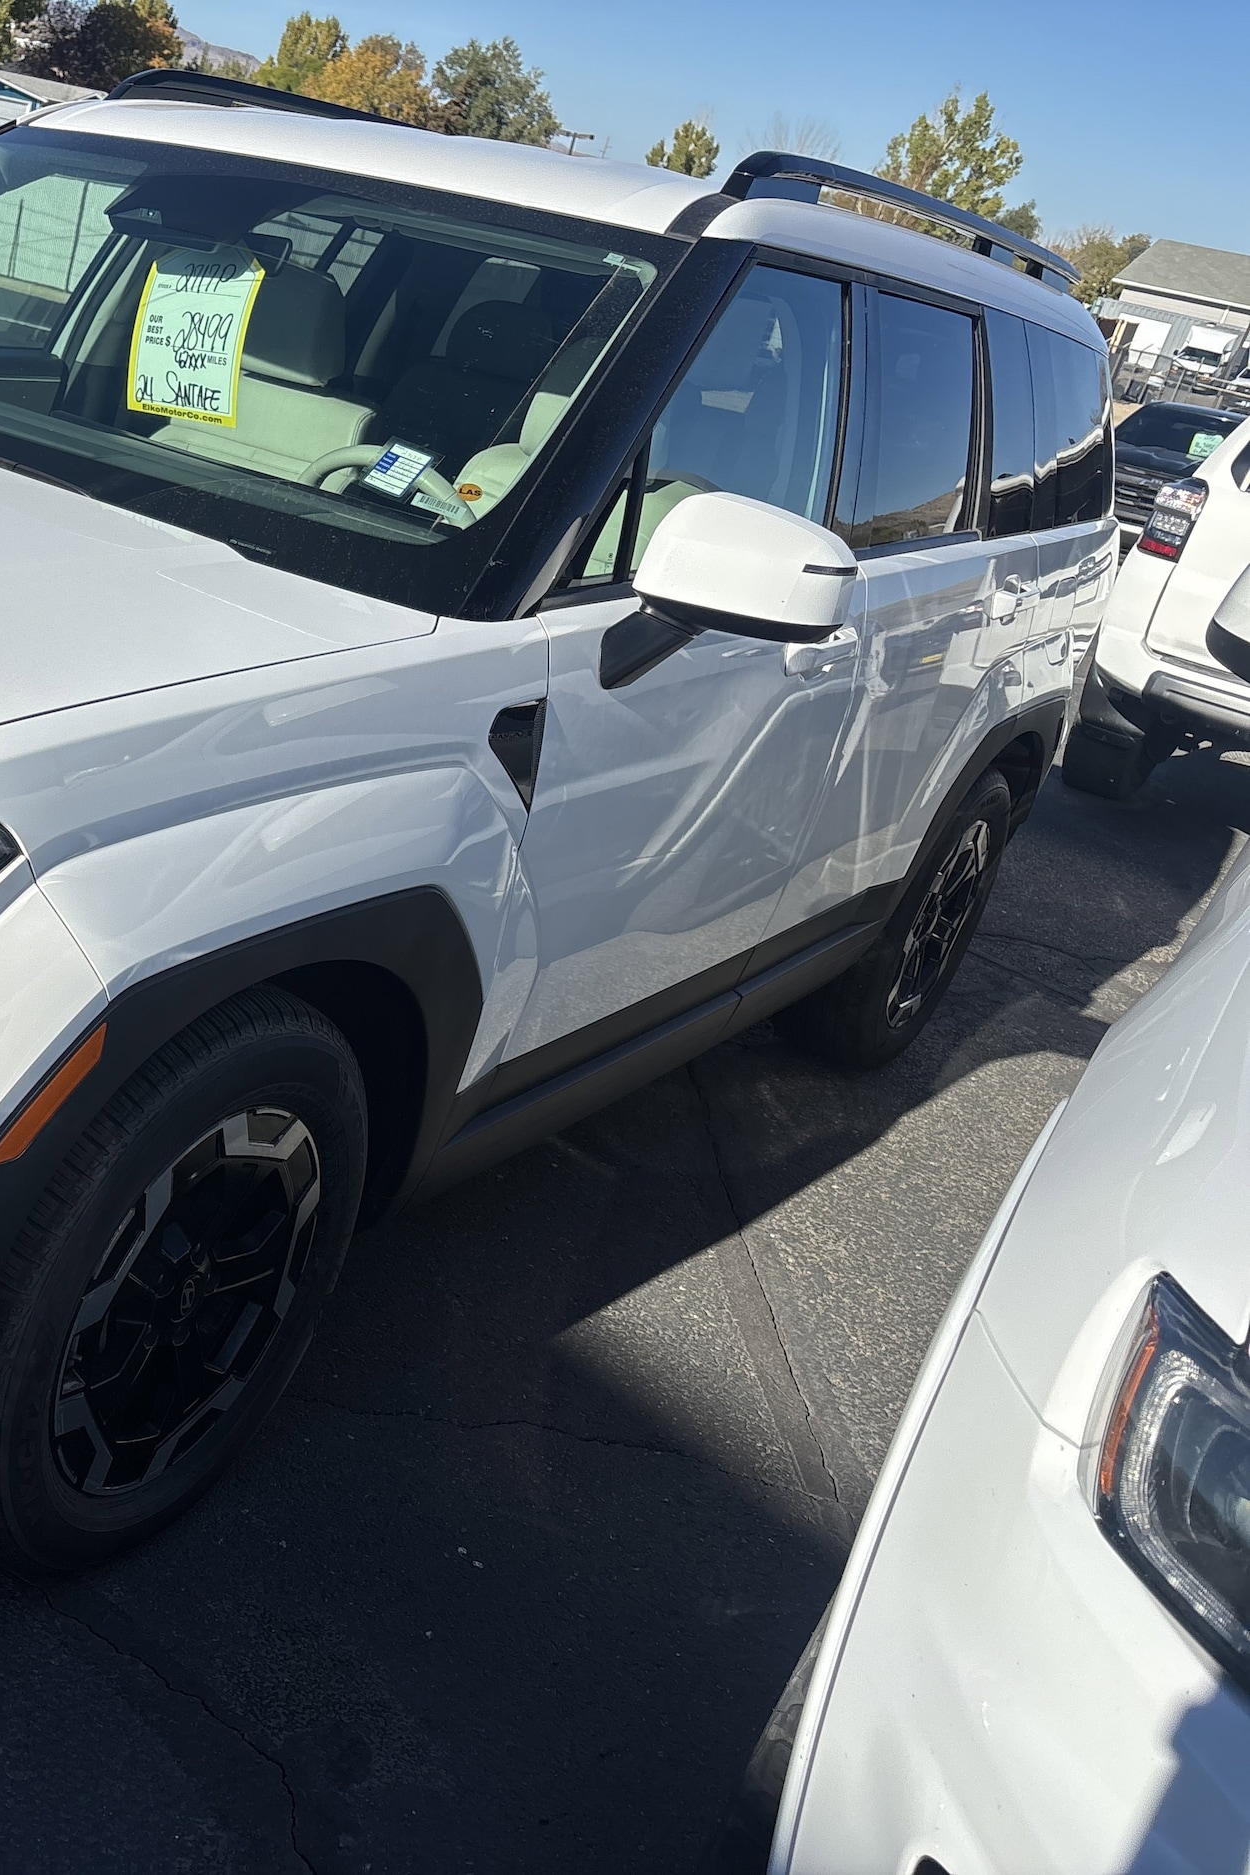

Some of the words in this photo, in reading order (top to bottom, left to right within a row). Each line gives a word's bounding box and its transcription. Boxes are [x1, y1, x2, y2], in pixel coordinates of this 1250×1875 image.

[149, 314, 163, 324] OUR
[145, 335, 164, 346] PRICE
[173, 311, 234, 353] 28499
[147, 325, 164, 335] BEST
[207, 355, 227, 366] MILES
[135, 374, 154, 403] 24
[142, 403, 223, 425] ElkoMotorCo.com
[459, 487, 481, 497] LAS
